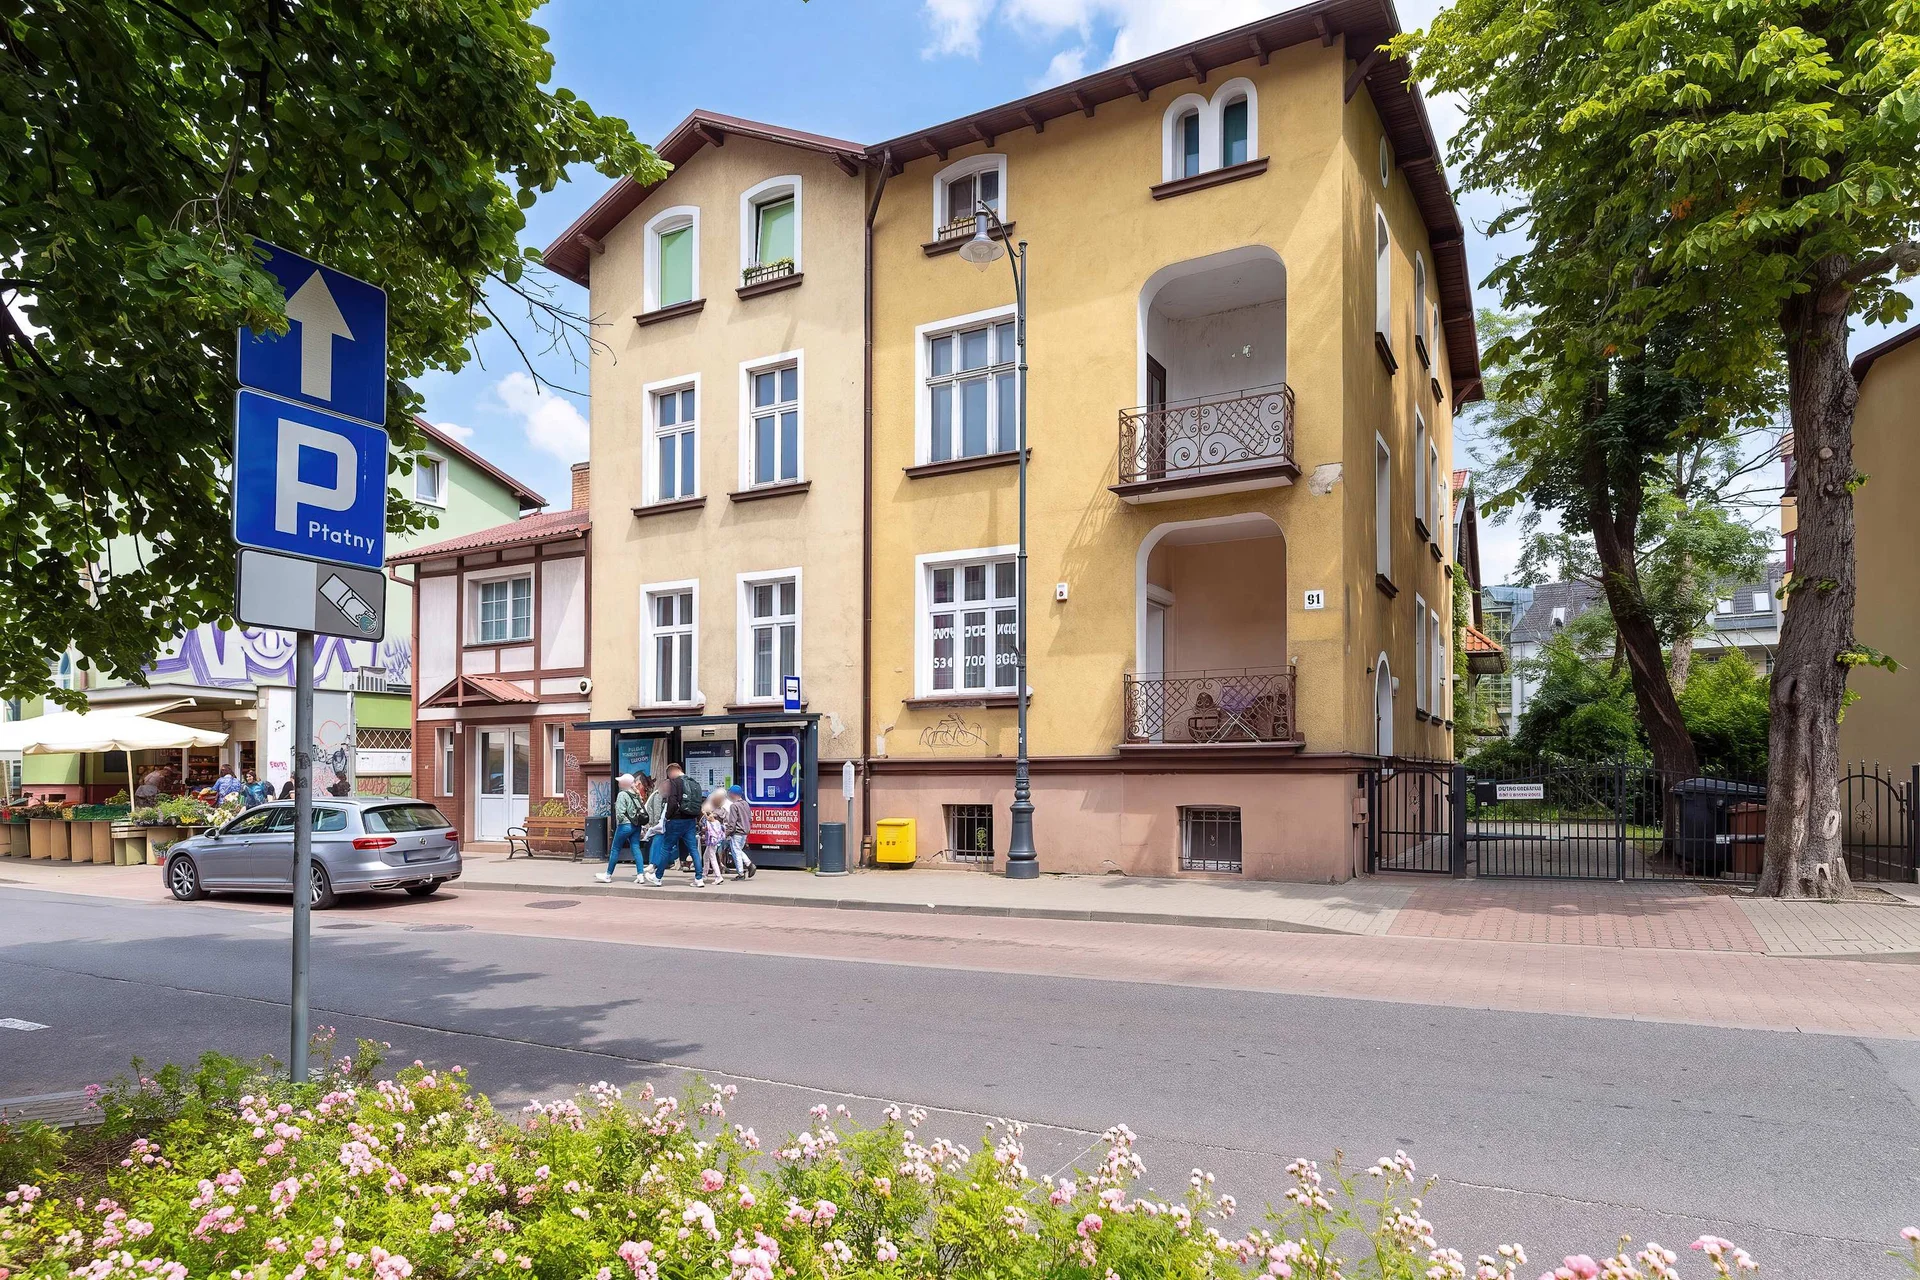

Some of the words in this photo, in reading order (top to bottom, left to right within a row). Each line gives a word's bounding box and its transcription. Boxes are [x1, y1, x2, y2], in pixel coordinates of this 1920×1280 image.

[275, 417, 358, 535] P
[308, 520, 375, 555] Płatny
[756, 744, 789, 798] P
